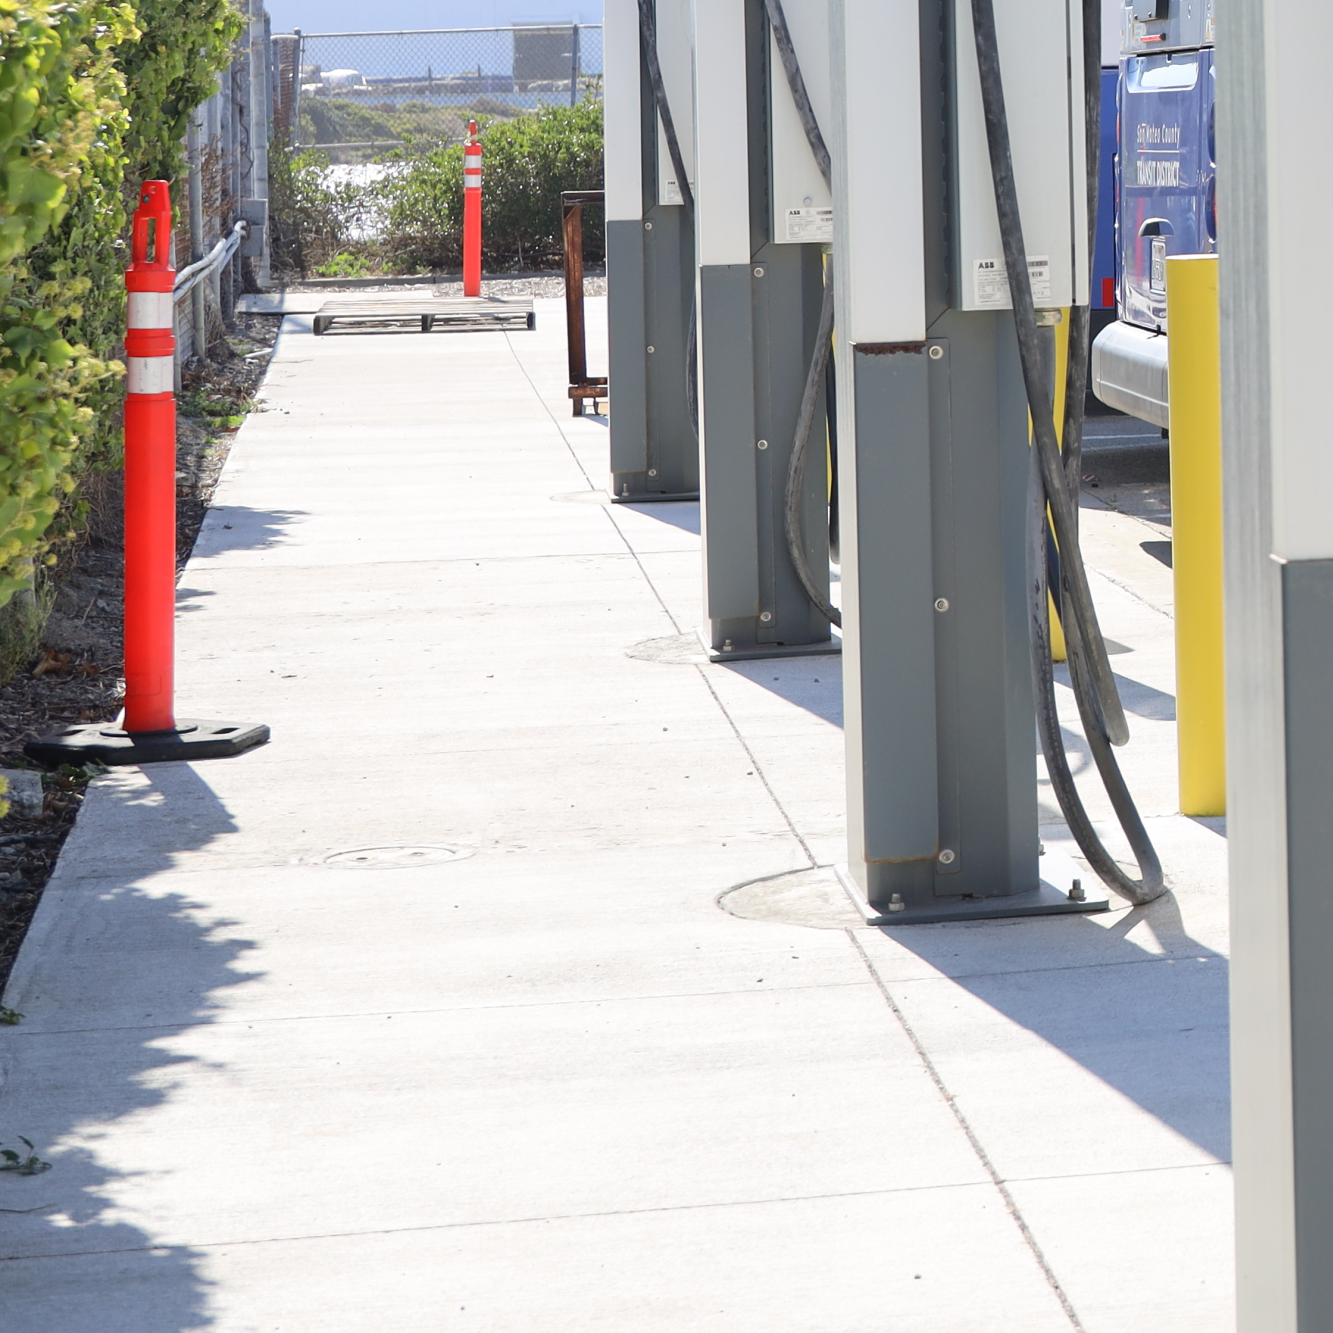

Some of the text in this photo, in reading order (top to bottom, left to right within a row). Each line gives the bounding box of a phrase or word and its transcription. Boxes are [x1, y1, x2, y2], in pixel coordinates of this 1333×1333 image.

[1162, 122, 1180, 148] County
[1137, 161, 1156, 185] TRANSIT
[1156, 161, 1179, 187] DISTRICT
